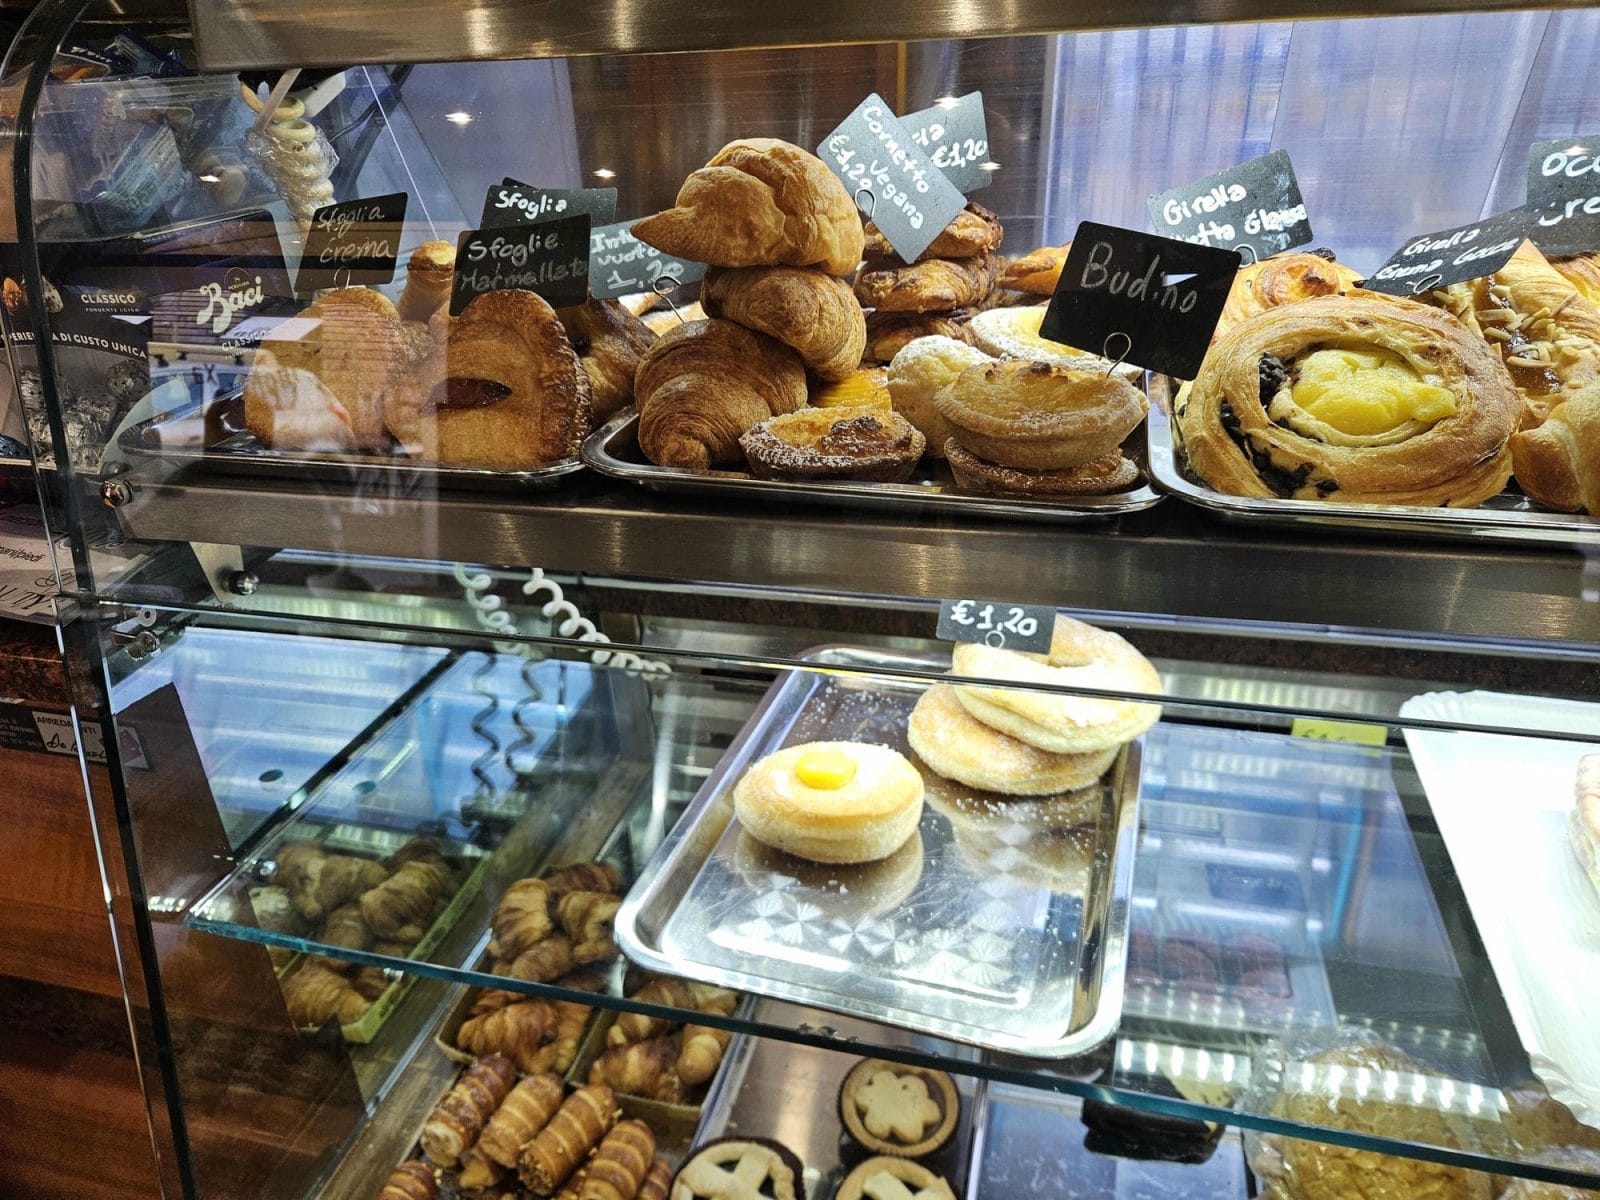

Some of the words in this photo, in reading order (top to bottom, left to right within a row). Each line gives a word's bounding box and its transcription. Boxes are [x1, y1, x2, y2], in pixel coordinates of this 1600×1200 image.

[494, 190, 567, 219] Sfoglia
[1163, 184, 1247, 225] Girella
[1402, 228, 1480, 256] Girella
[1080, 241, 1199, 313] Budino
[80, 294, 136, 304] CLASSICO
[196, 276, 264, 334] Baci
[73, 334, 109, 348] GUSTO
[111, 342, 147, 360] UNICA
[951, 599, 1038, 637] €1,20
